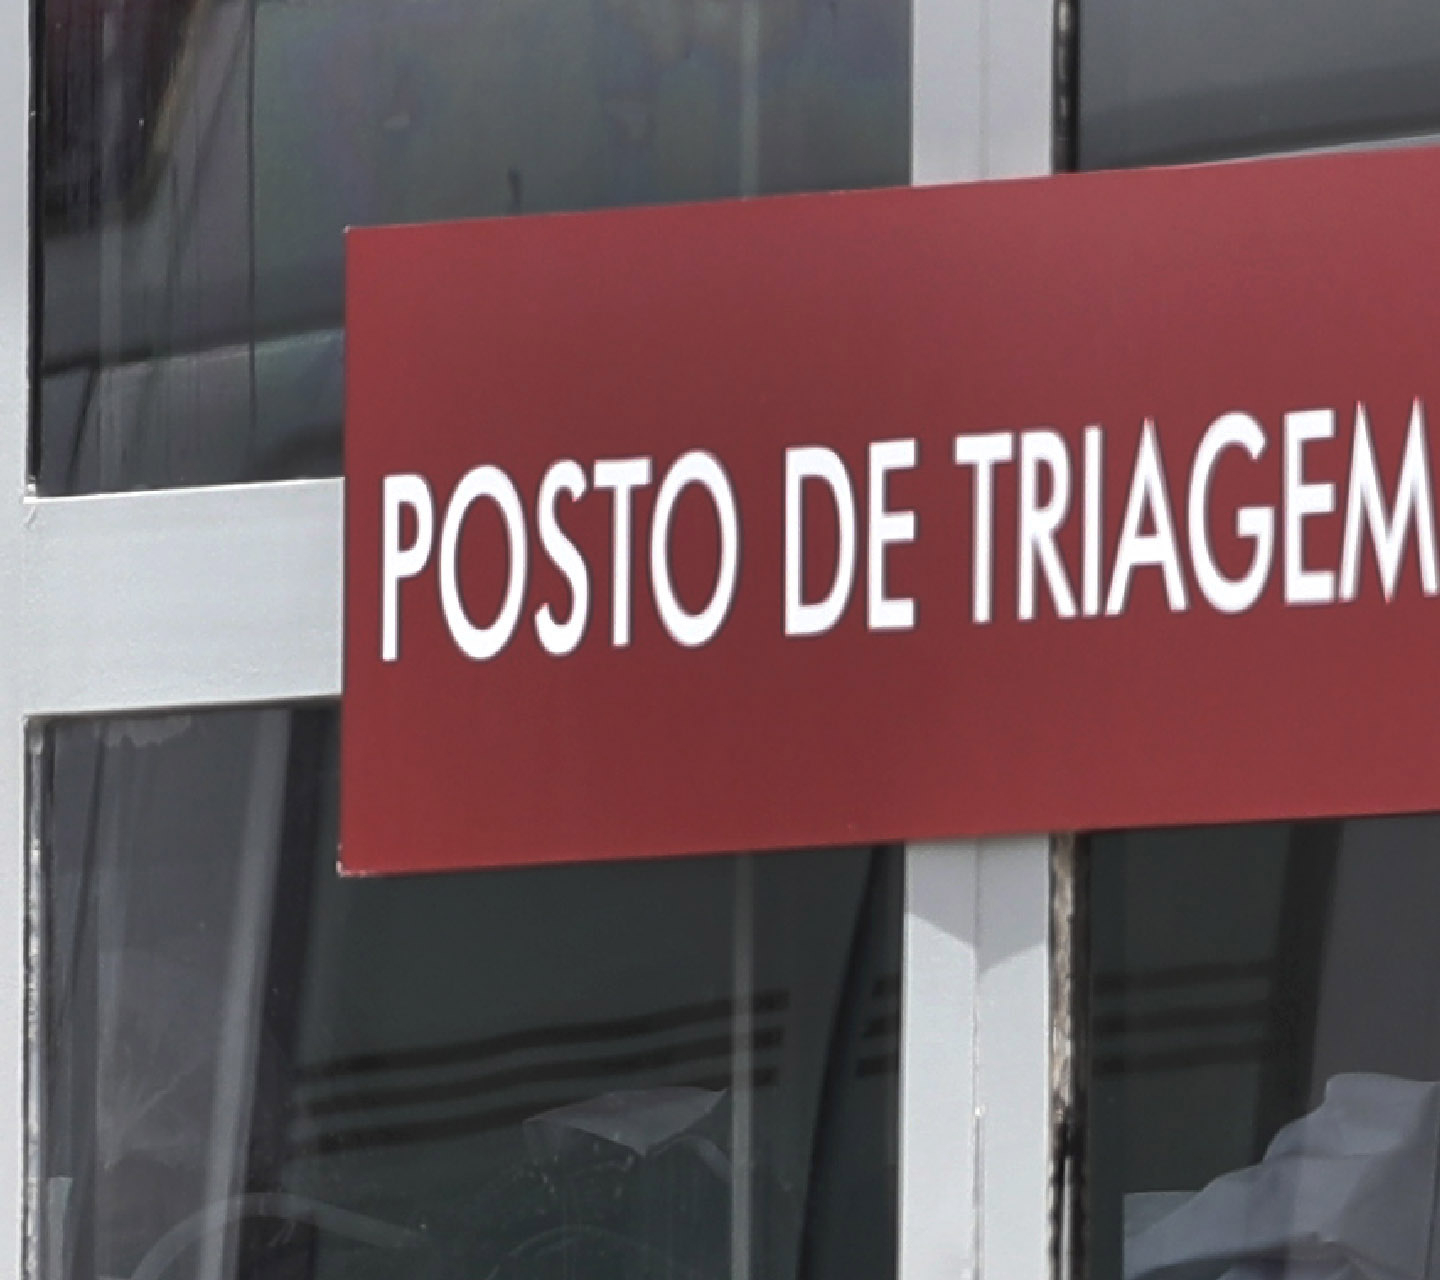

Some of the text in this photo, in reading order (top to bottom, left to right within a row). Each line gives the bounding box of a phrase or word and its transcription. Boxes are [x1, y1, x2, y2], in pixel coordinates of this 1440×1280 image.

[381, 399, 1440, 663] POSTO DE TRIAGEM
